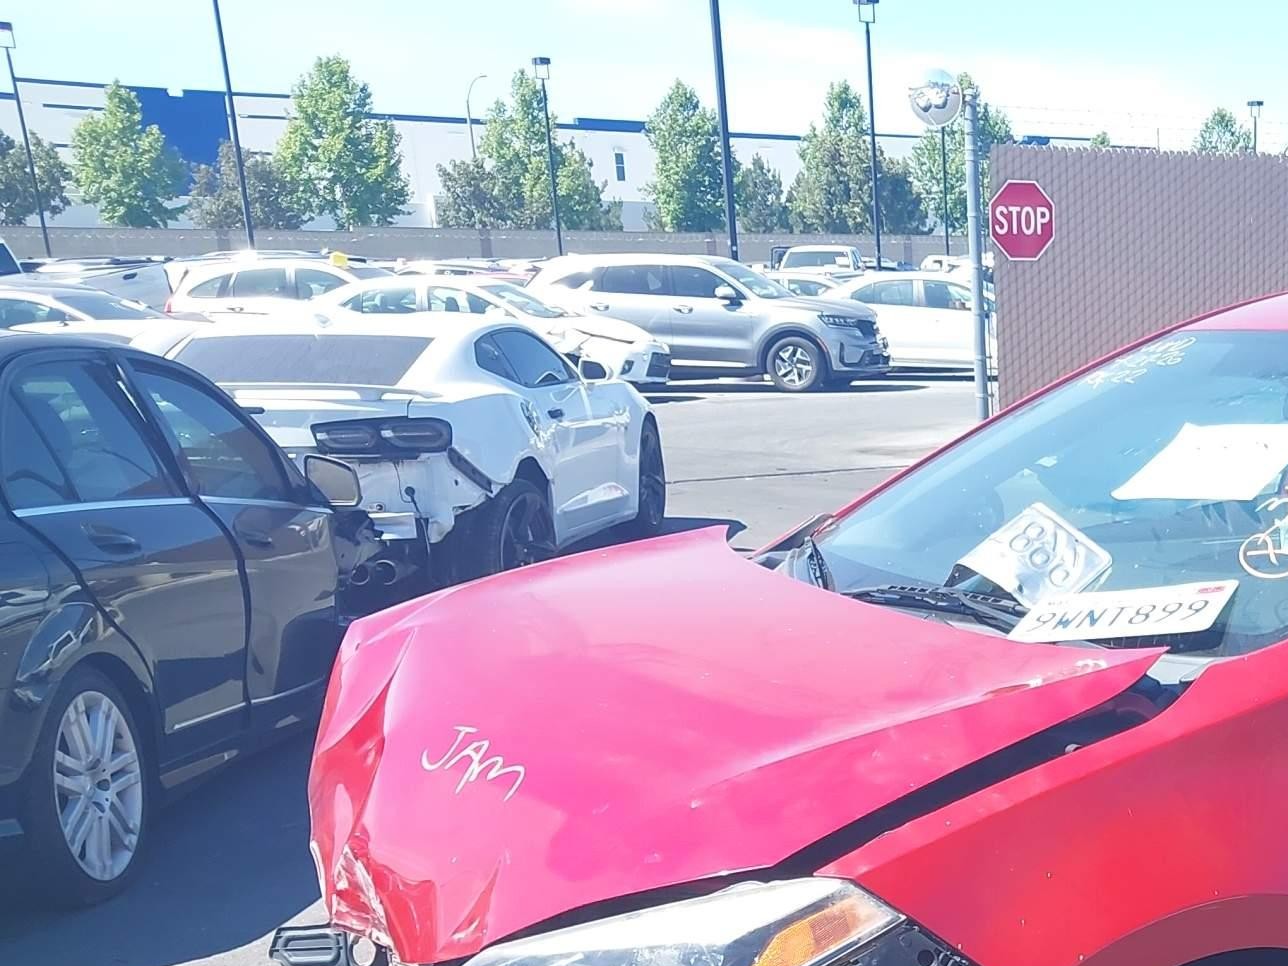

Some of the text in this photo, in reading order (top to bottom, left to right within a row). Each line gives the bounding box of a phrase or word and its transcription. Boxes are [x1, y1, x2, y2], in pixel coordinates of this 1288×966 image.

[994, 205, 1050, 236] STOP
[1026, 599, 1210, 633] 9WNT899
[421, 725, 526, 803] JAM
